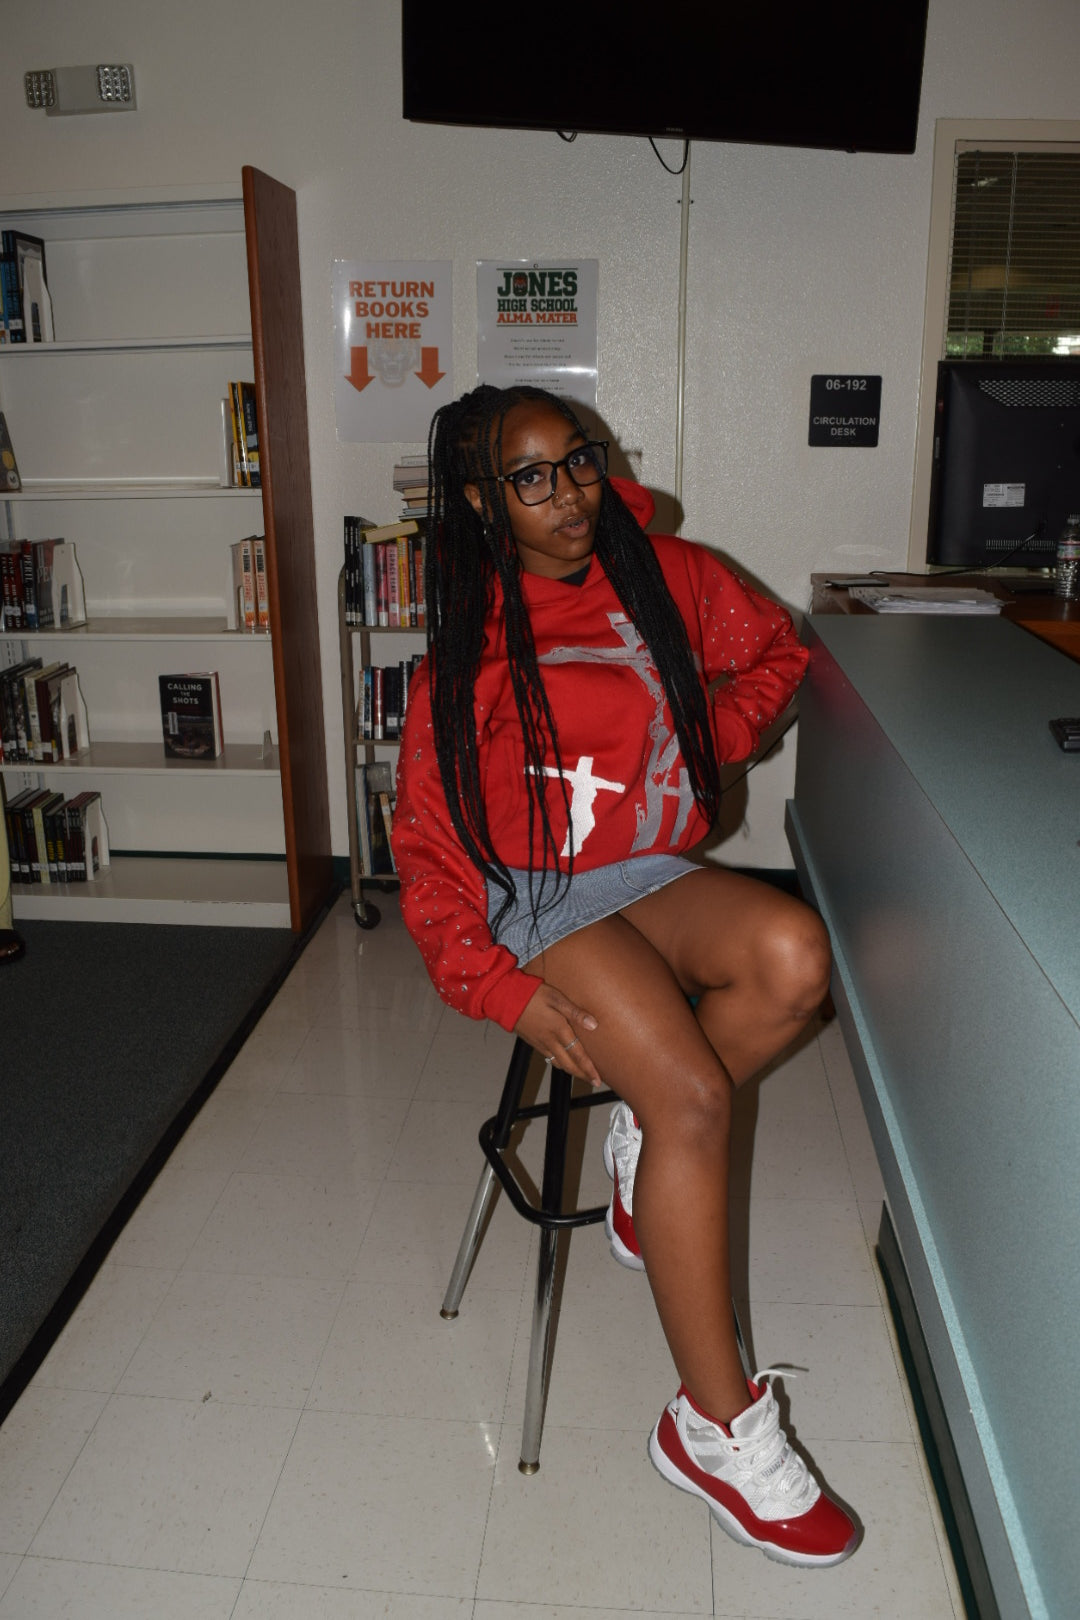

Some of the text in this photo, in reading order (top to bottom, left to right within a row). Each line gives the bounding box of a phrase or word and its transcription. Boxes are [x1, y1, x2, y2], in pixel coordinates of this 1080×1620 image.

[349, 281, 435, 298] RETURN
[497, 271, 578, 297] JONES
[355, 301, 429, 318] BOOKS
[497, 298, 578, 312] HIGH SCHOOL
[497, 312, 577, 324] ALMA MATER
[366, 322, 422, 339] HERE
[825, 379, 867, 391] 06-192
[813, 416, 876, 425] CIRCULATION
[830, 427, 857, 436] DESK
[167, 683, 203, 691] CALLING
